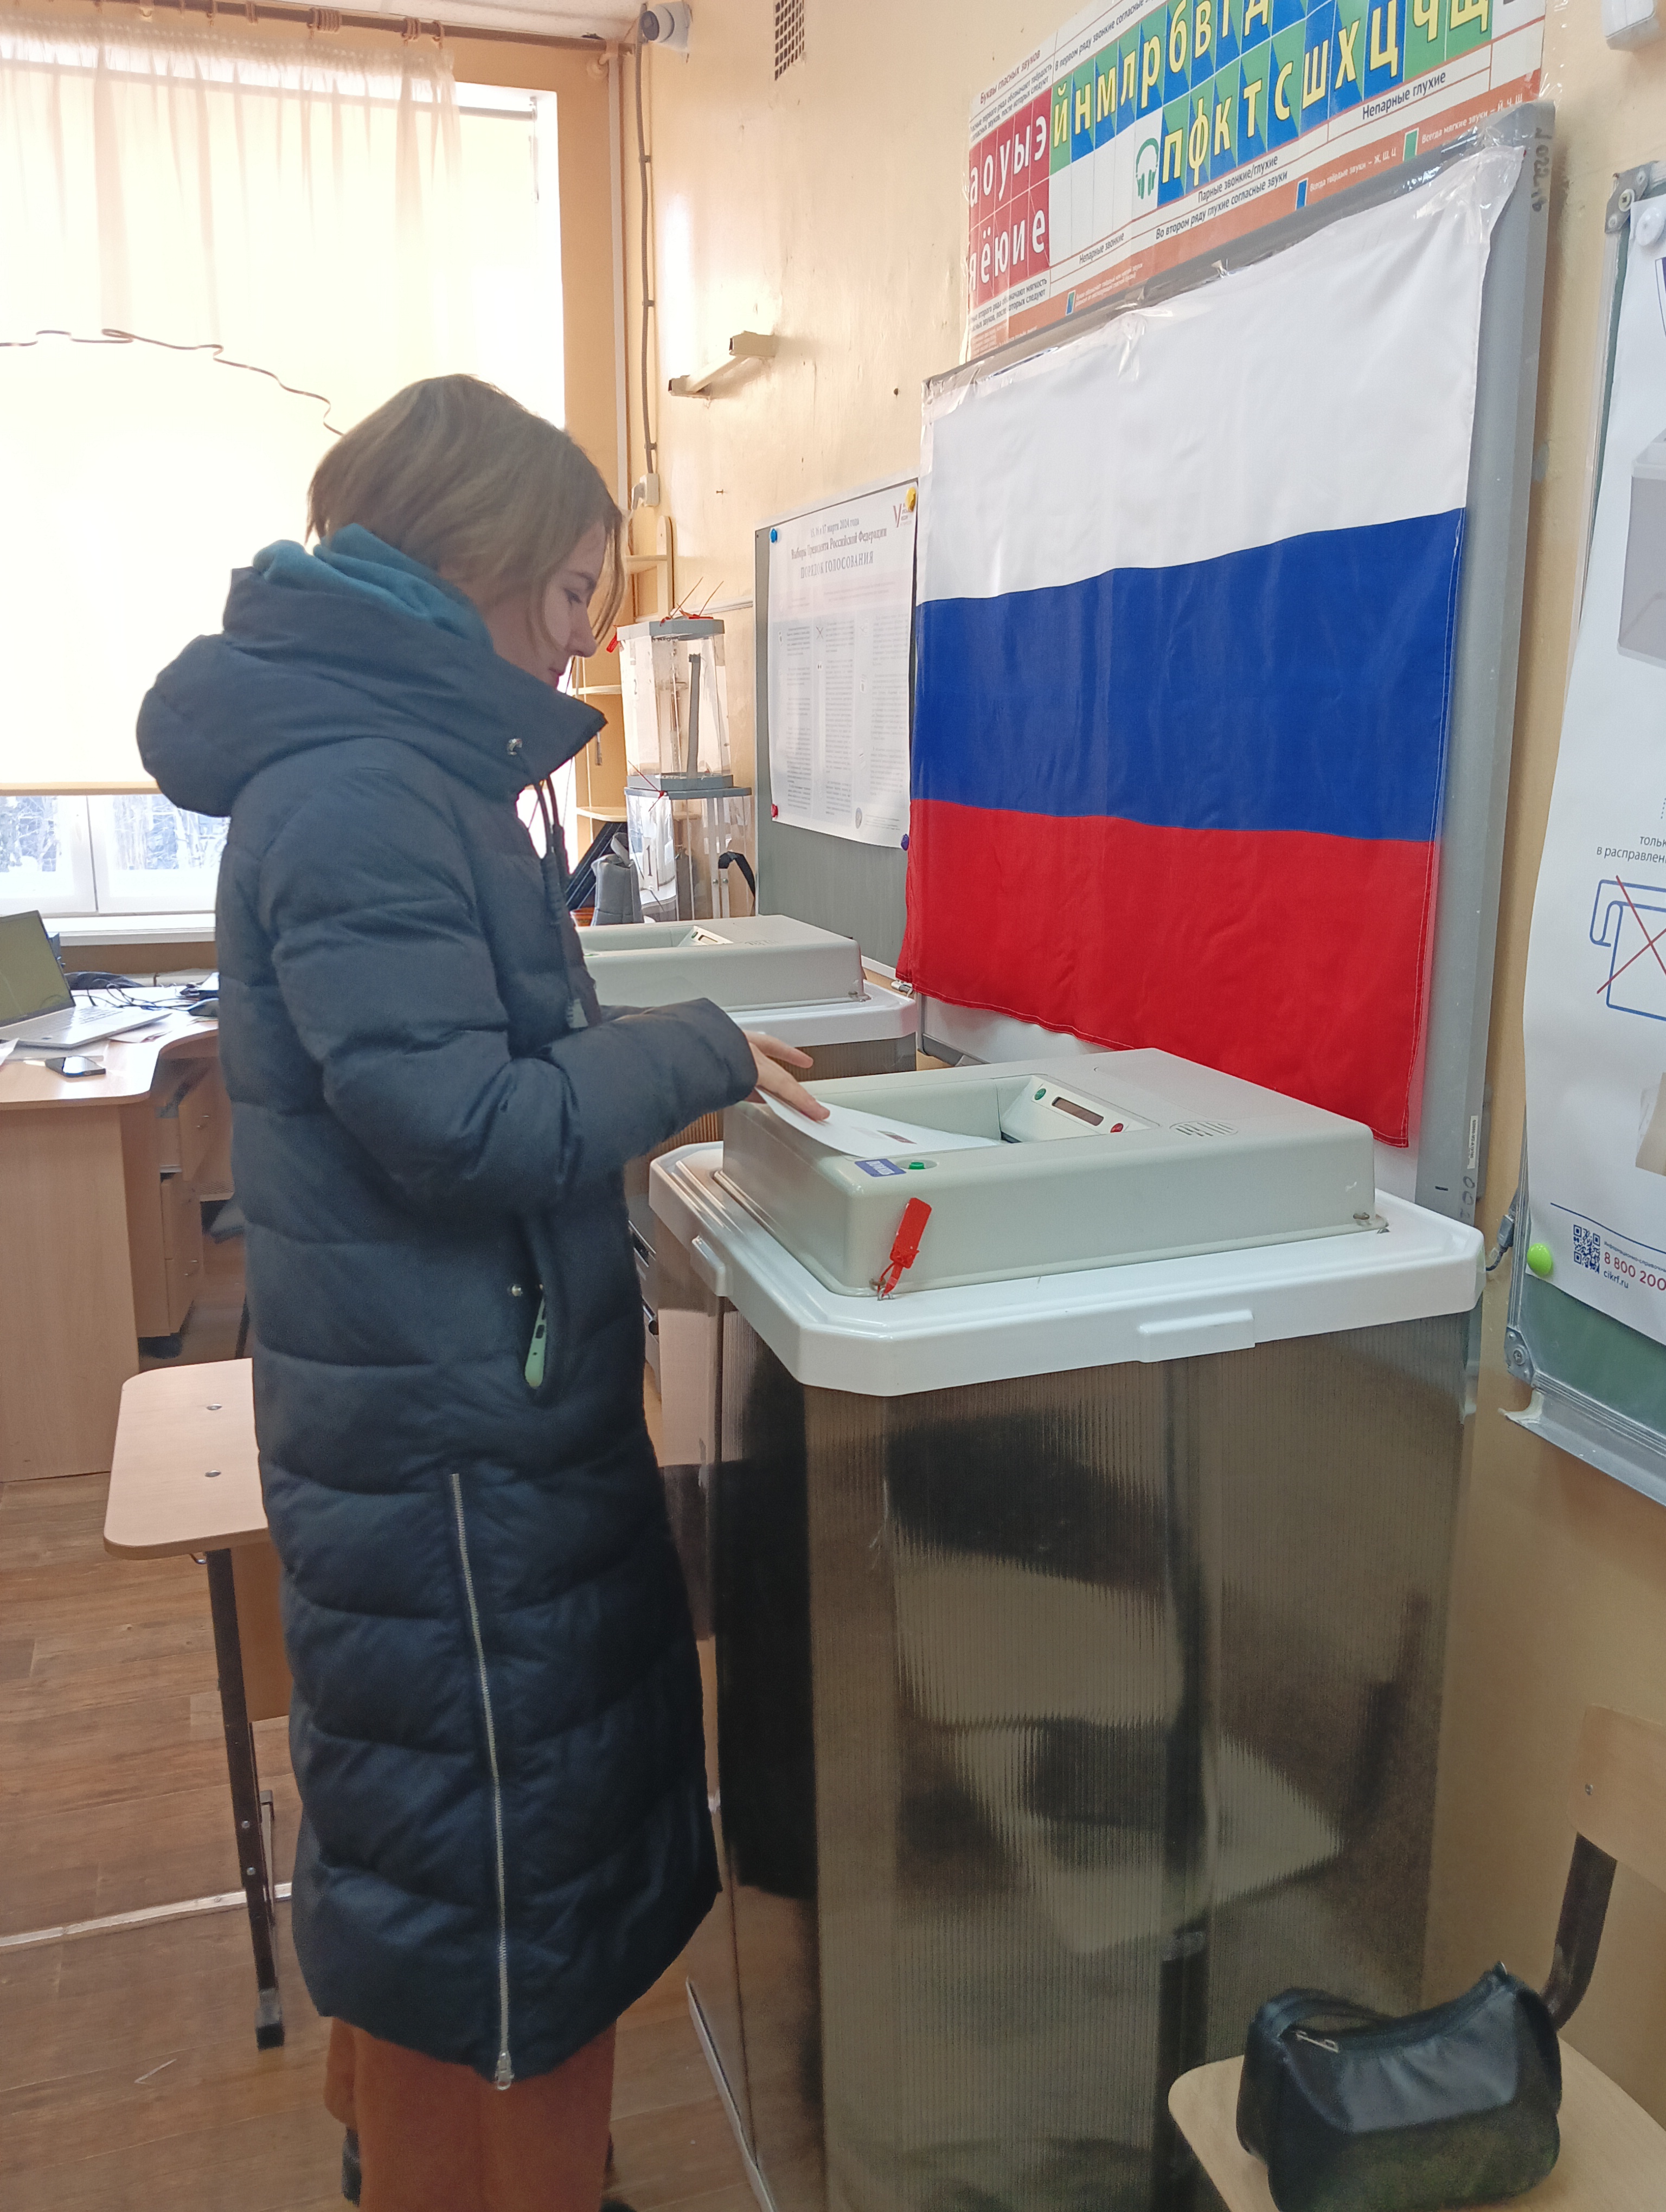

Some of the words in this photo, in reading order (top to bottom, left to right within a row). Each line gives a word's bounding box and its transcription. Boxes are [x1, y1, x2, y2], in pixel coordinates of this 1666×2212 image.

[1060, 48, 1078, 66] первом
[1079, 37, 1092, 55] ряду
[1093, 20, 1115, 43] звонкие
[1116, 0, 1144, 25] согласные
[981, 85, 997, 105] Буквы
[998, 66, 1020, 91] гласных
[1021, 50, 1040, 72] звуков
[1363, 89, 1410, 120] Непарные
[1413, 72, 1446, 97] глухие
[1422, 128, 1442, 144] Всегда
[1444, 119, 1466, 133] мягкие
[1469, 110, 1488, 125] звуки
[1198, 183, 1222, 203] Парные
[1224, 156, 1278, 190] звонкие/глухие
[1310, 179, 1325, 192] Всегда
[1349, 162, 1366, 174] звуки
[1156, 228, 1164, 240] Во
[1166, 217, 1189, 236] втором
[1190, 211, 1206, 227] ряду
[1207, 198, 1229, 216] глухие
[1231, 183, 1265, 205] согласные
[1268, 171, 1287, 189] звуки
[1079, 245, 1104, 265] Непарные
[1105, 233, 1124, 250] звонкие
[1009, 299, 1025, 311] оторых
[1026, 289, 1045, 303] следуют
[1027, 278, 1047, 293] мягкость
[830, 532, 857, 550] Российской
[858, 528, 887, 544] Федерации
[800, 562, 824, 578] ПОРЯДОК
[825, 551, 874, 573] ГОЛОСОВАНИЯ
[1597, 847, 1602, 855] в
[1604, 847, 1666, 864] расправлен
[1604, 1252, 1611, 1264] 8
[1614, 1257, 1636, 1277] 800
[1639, 1270, 1666, 1291] 200
[1604, 1270, 1629, 1289] cikrf.ru
